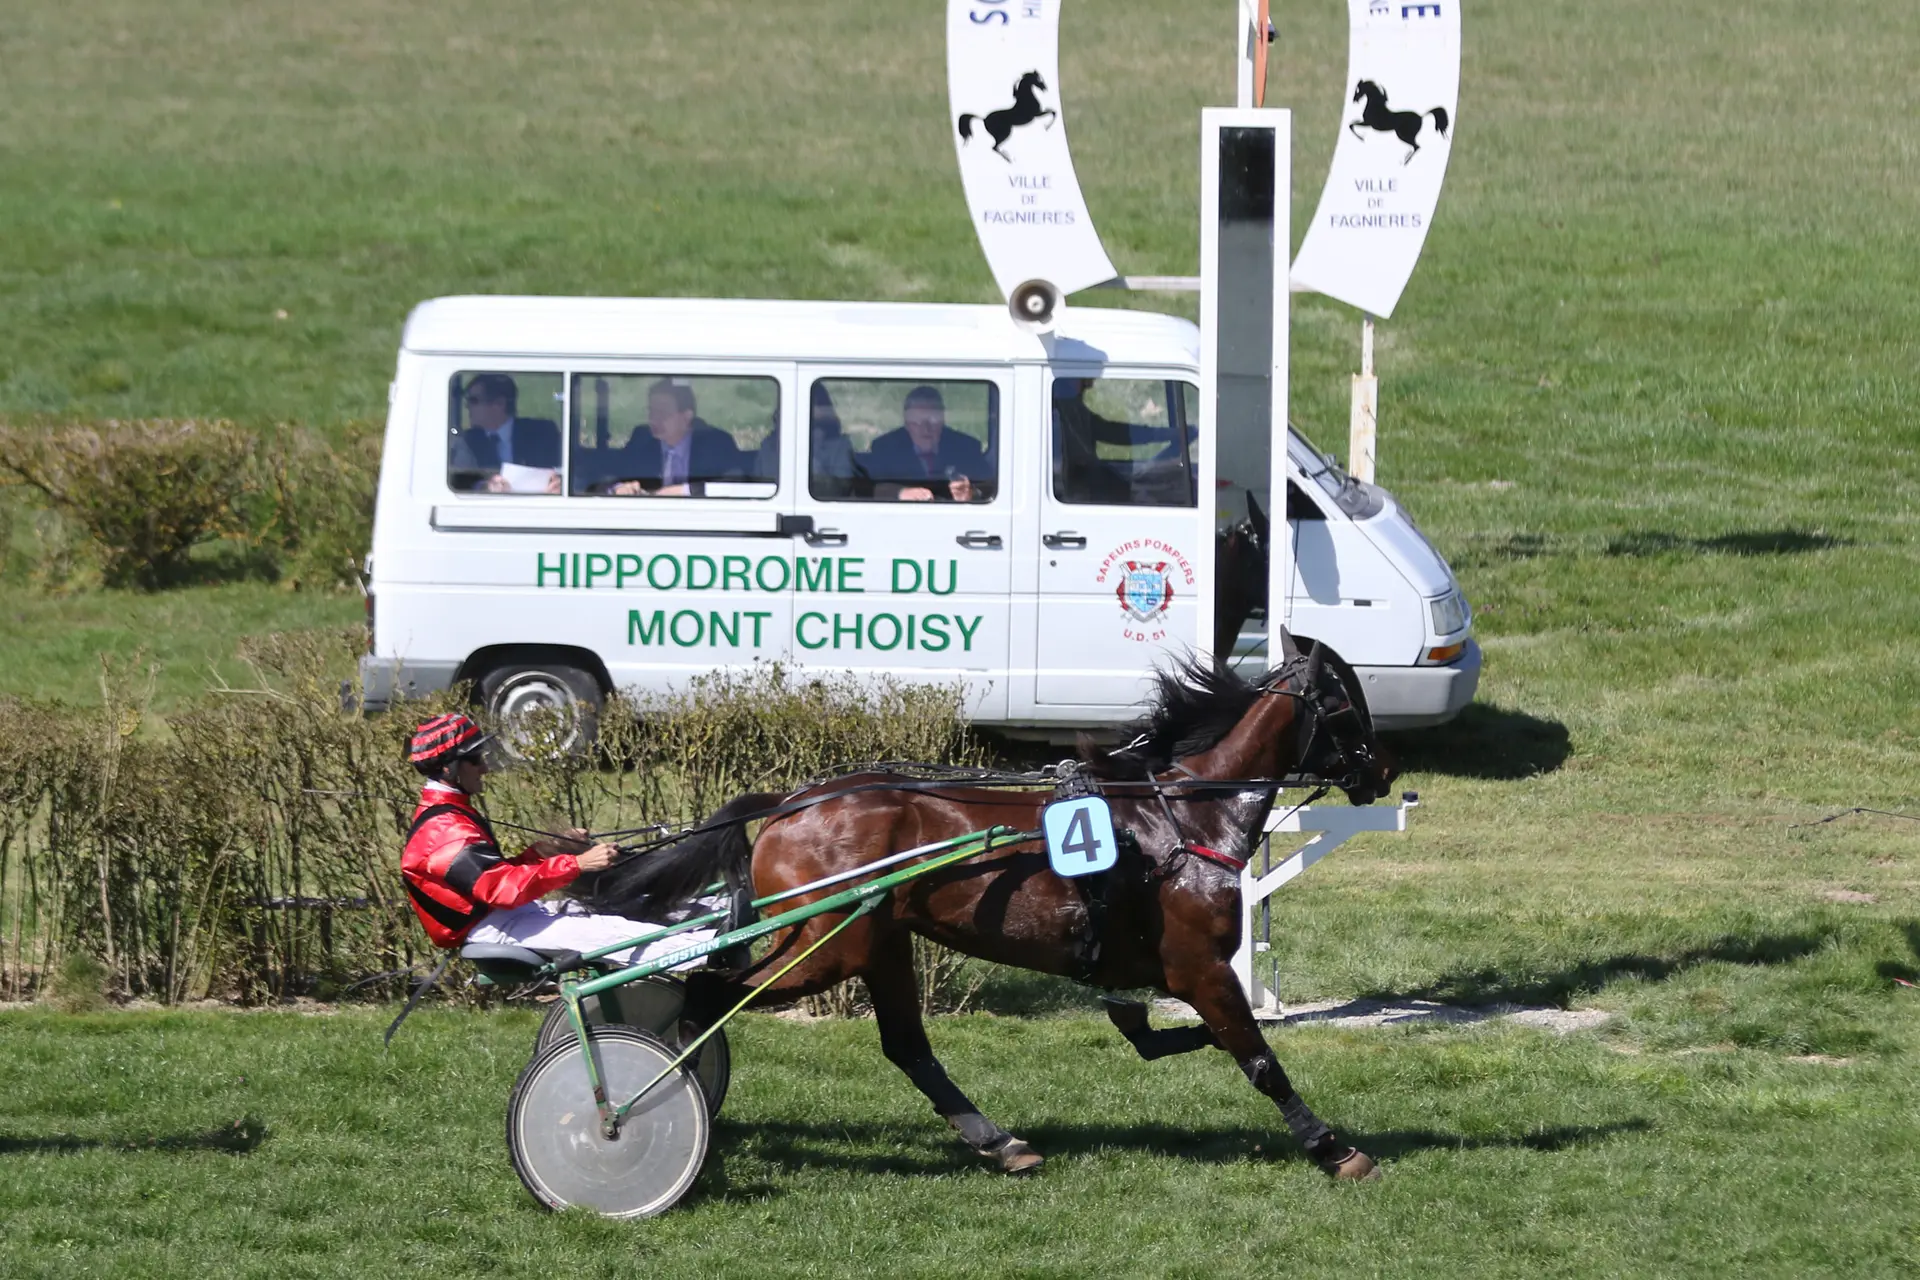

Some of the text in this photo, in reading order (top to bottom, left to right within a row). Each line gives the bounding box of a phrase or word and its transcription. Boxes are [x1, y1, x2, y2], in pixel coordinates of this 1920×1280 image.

[970, 0, 1010, 24] S
[1008, 175, 1051, 189] VILLE
[1354, 179, 1397, 192] VILLE
[1021, 195, 1037, 205] DE
[1367, 198, 1384, 209] DE
[983, 211, 1076, 224] FAGNIERES
[1330, 214, 1422, 228] FAGNIERES
[1096, 537, 1195, 586] SAPEURS POMPIERS
[537, 552, 957, 595] HIPPODROME DU
[628, 609, 982, 652] MONT CHOISY
[1123, 628, 1167, 642] U.D. 51
[1061, 806, 1102, 863] 4
[658, 937, 721, 968] CUSTOM
